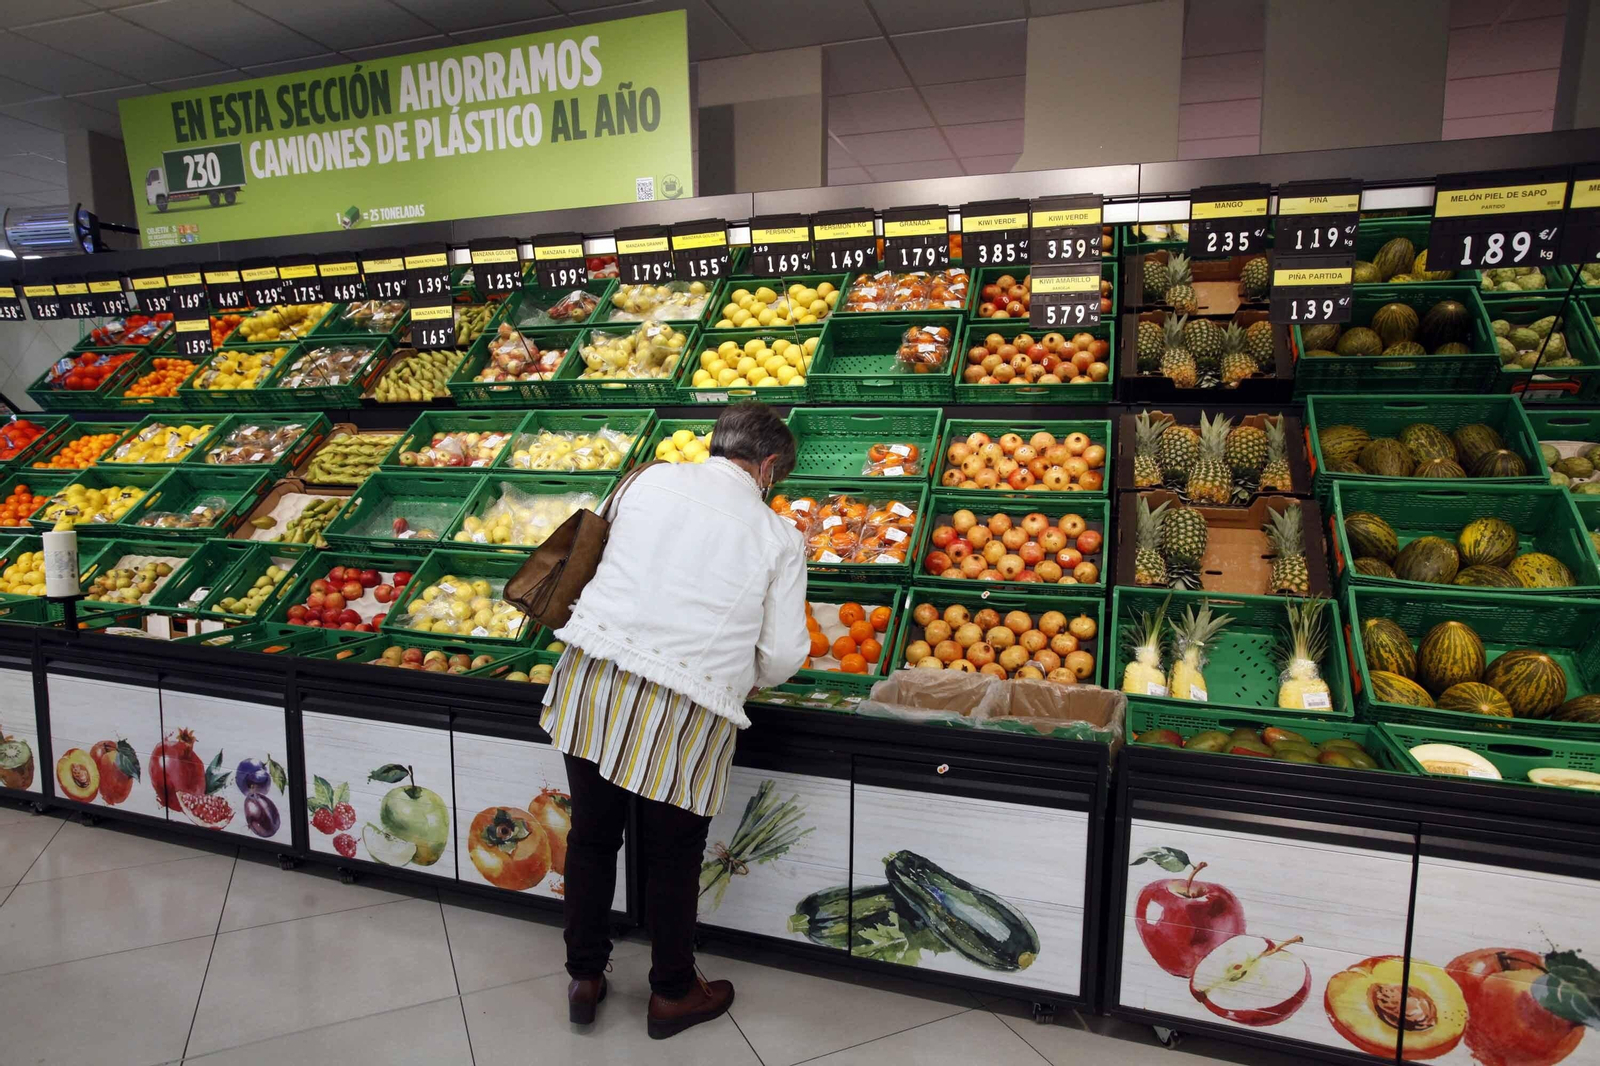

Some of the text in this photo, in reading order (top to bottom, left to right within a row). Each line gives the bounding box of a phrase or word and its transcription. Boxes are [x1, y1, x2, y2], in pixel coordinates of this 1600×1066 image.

[171, 36, 603, 143] EN ESTA SECCIÓN AHORRAMOS
[183, 81, 661, 189] 230 CAMIONES DE PLÁSTICO AL AÑO
[1450, 189, 1547, 203] MELÓN PIEL DE SAPO
[1214, 201, 1243, 209] MANGO
[370, 209, 380, 221] 25
[380, 204, 425, 220] TONELADAS
[996, 217, 1017, 225] VERDE
[1065, 213, 1089, 221] VERDE
[820, 223, 852, 231] PERSIMON
[1344, 239, 1353, 247] kg
[1091, 248, 1099, 256] kg
[1540, 249, 1554, 260] kg
[941, 256, 949, 264] kg
[1288, 271, 1343, 280] PIÑA PARTIDA
[1055, 276, 1091, 284] AMARILLO
